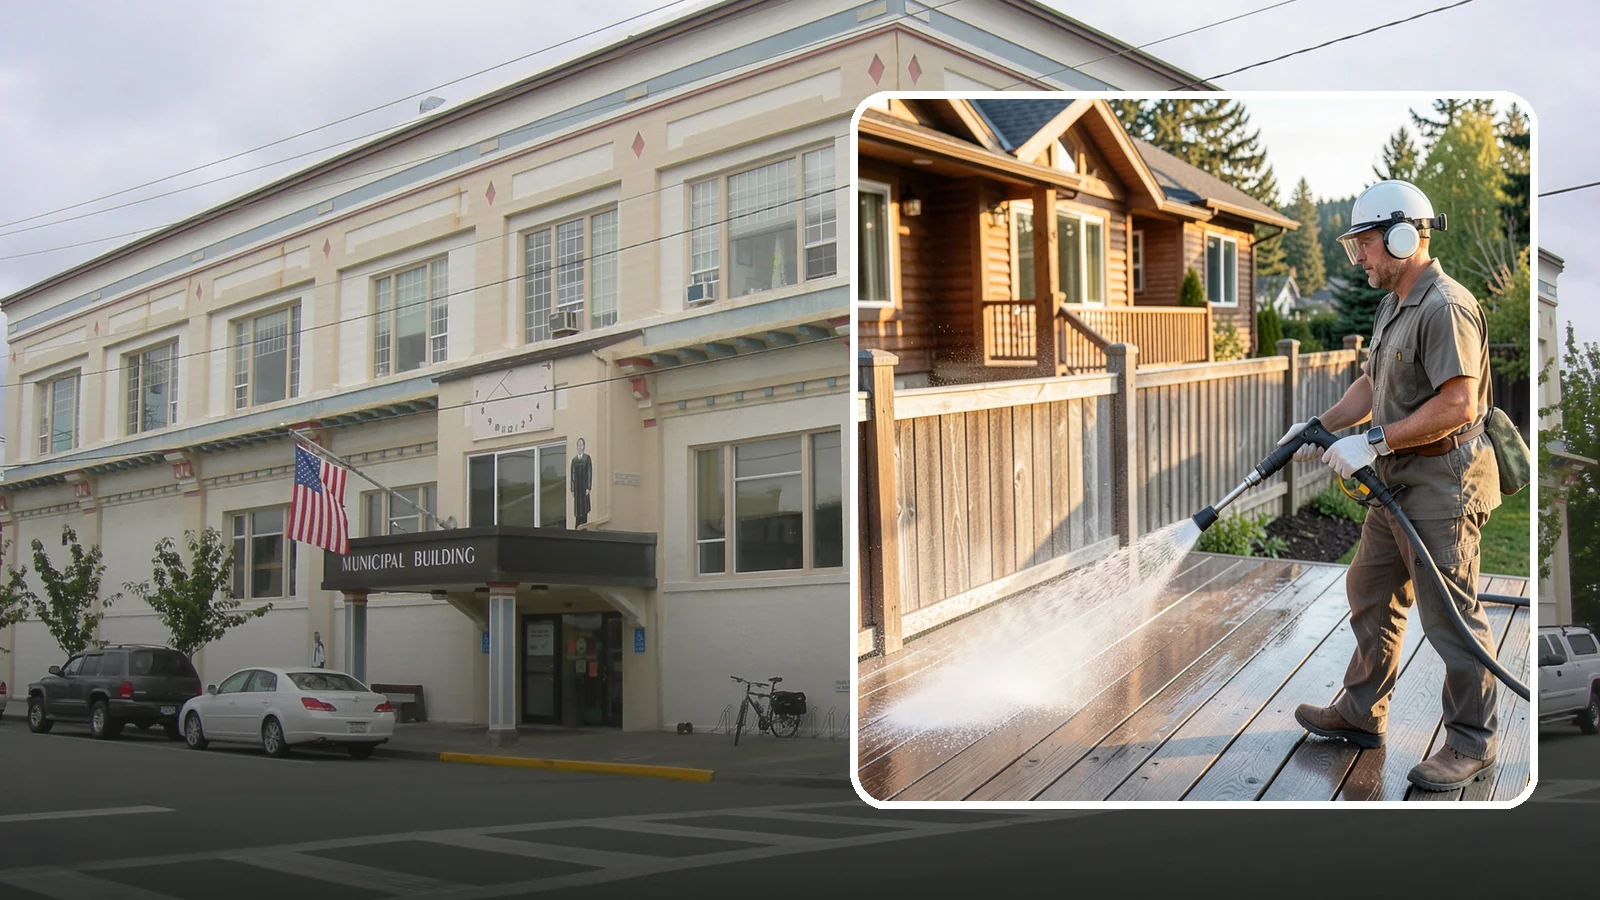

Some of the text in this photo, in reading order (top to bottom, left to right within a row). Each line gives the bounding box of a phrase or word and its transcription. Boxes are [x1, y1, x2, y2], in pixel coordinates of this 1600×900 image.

[547, 362, 552, 370] 6
[475, 390, 479, 398] 7
[536, 402, 540, 410] 4
[481, 407, 485, 415] 8
[488, 418, 492, 426] 9
[529, 414, 533, 422] 3
[495, 424, 500, 432] 10
[521, 420, 525, 428] 2
[342, 546, 475, 572] MUNICIPAL BUILDING
